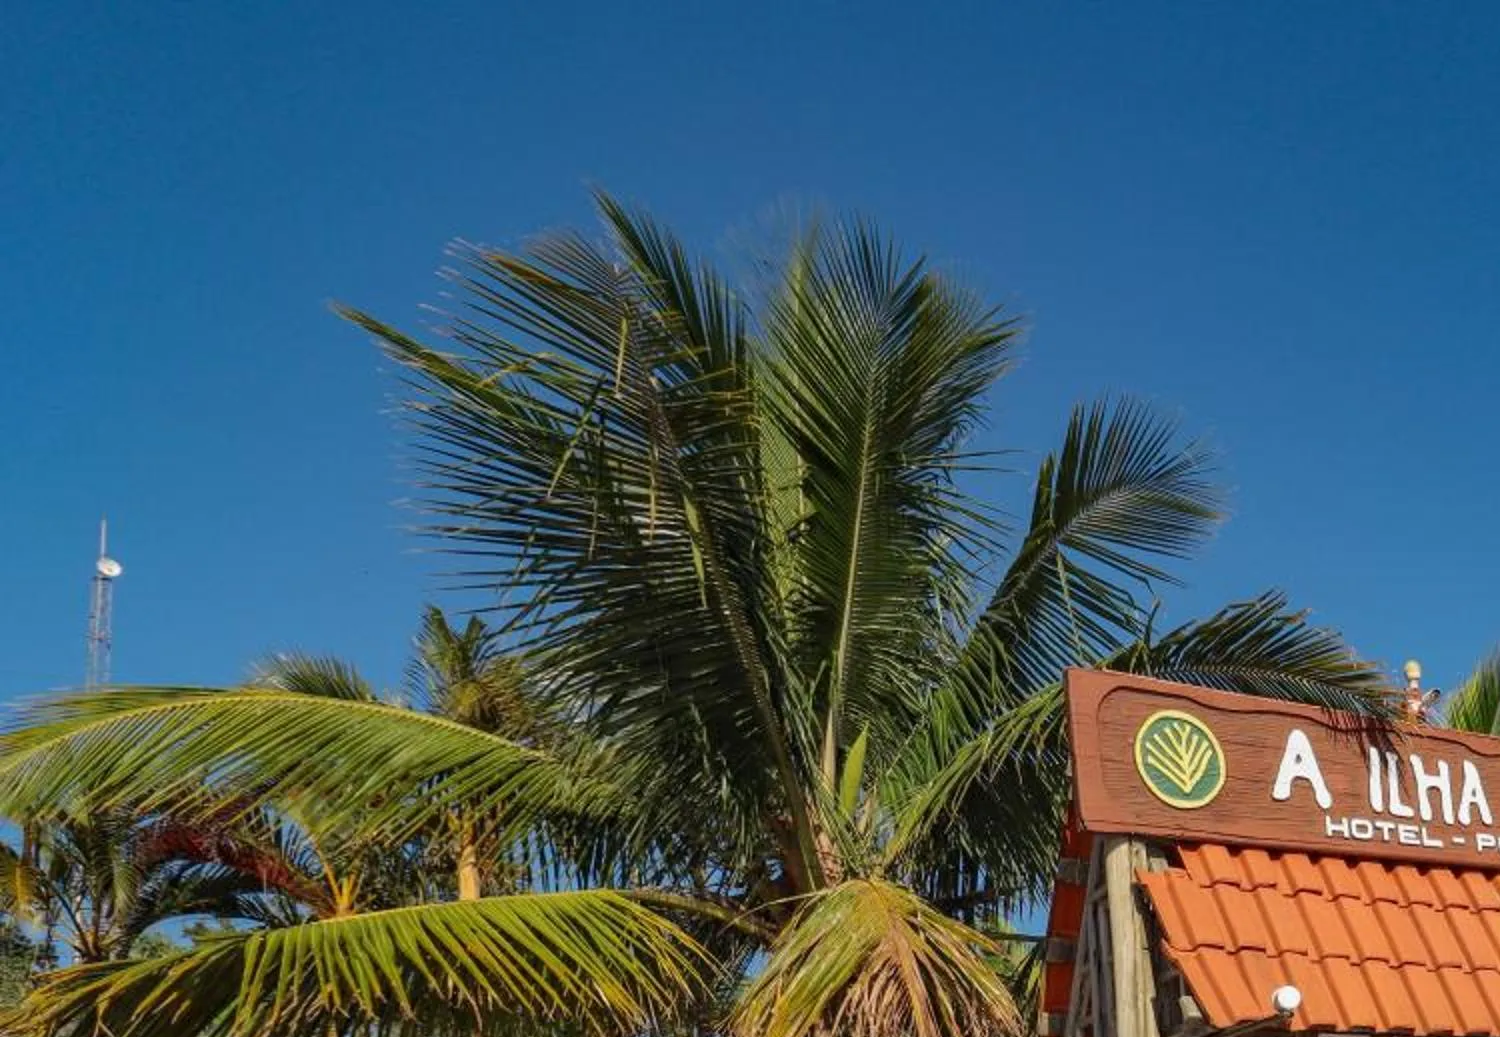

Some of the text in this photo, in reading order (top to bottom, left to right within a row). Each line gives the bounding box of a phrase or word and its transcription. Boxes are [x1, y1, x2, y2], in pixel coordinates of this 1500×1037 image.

[1272, 728, 1333, 809] A
[1368, 746, 1493, 826] ILHA
[1325, 815, 1443, 848] HOTEL
